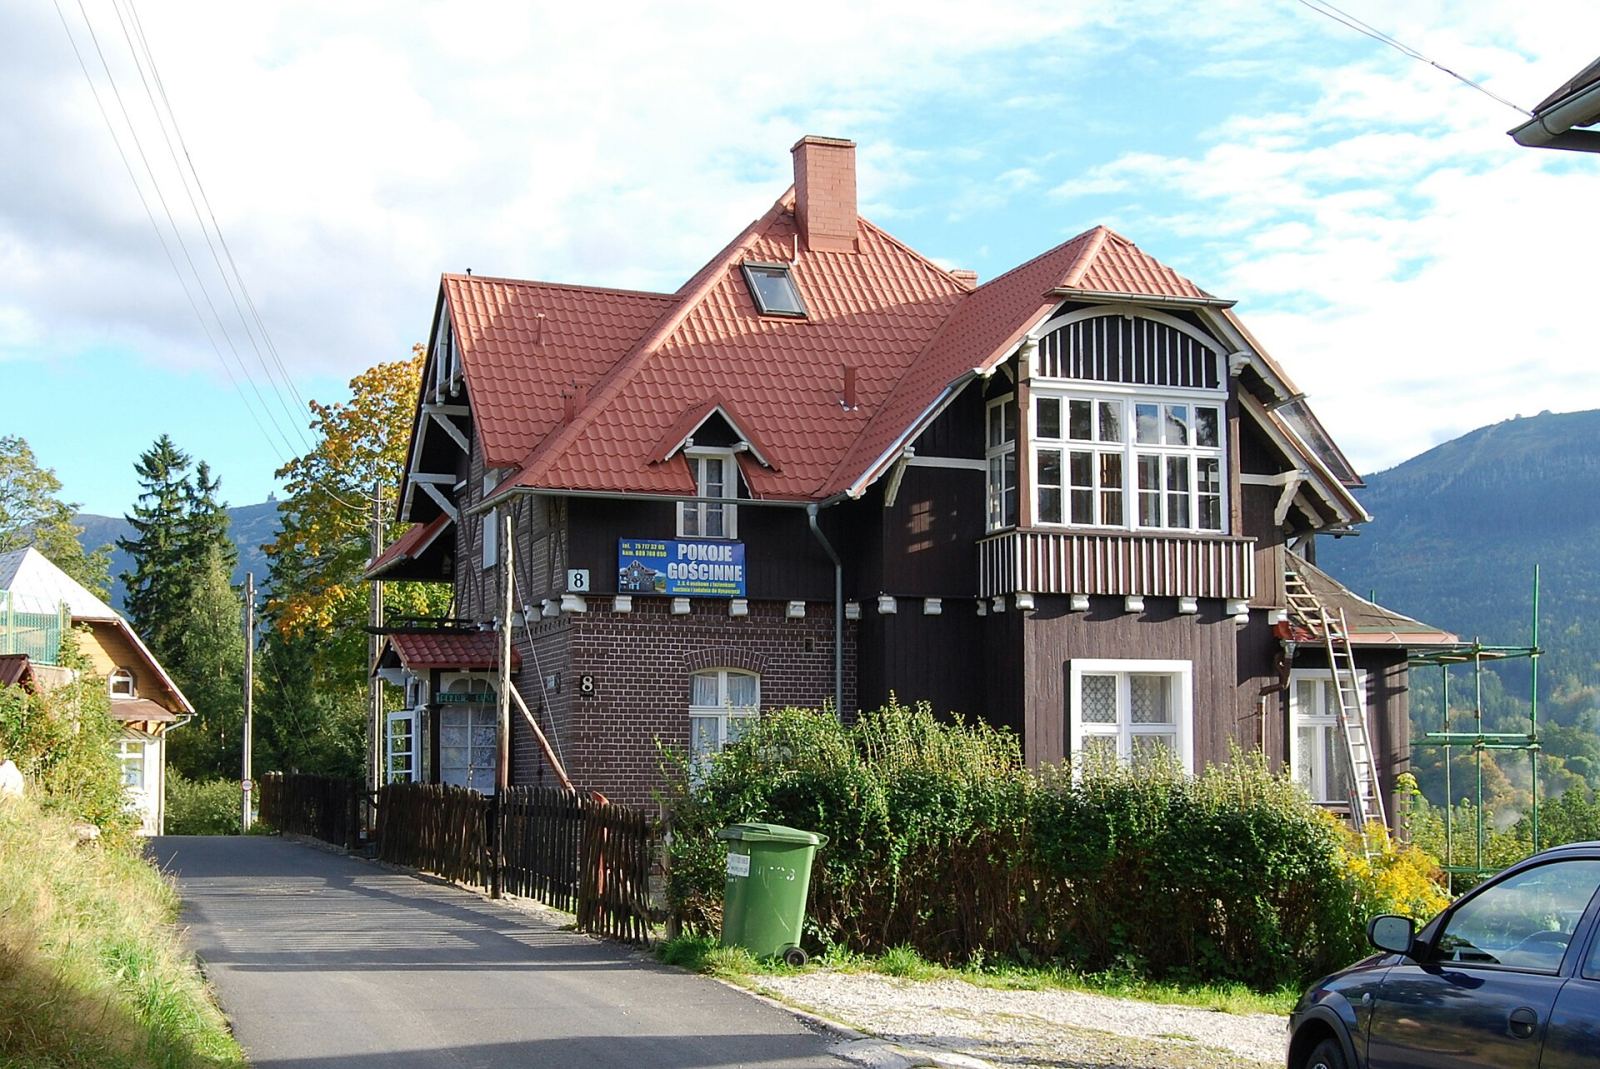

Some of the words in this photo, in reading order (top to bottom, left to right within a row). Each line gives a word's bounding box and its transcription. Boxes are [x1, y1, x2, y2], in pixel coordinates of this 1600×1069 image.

[677, 543, 733, 562] POKOJE
[667, 560, 743, 582] GOŚCINNE
[573, 572, 584, 588] 8
[581, 676, 593, 692] 8
